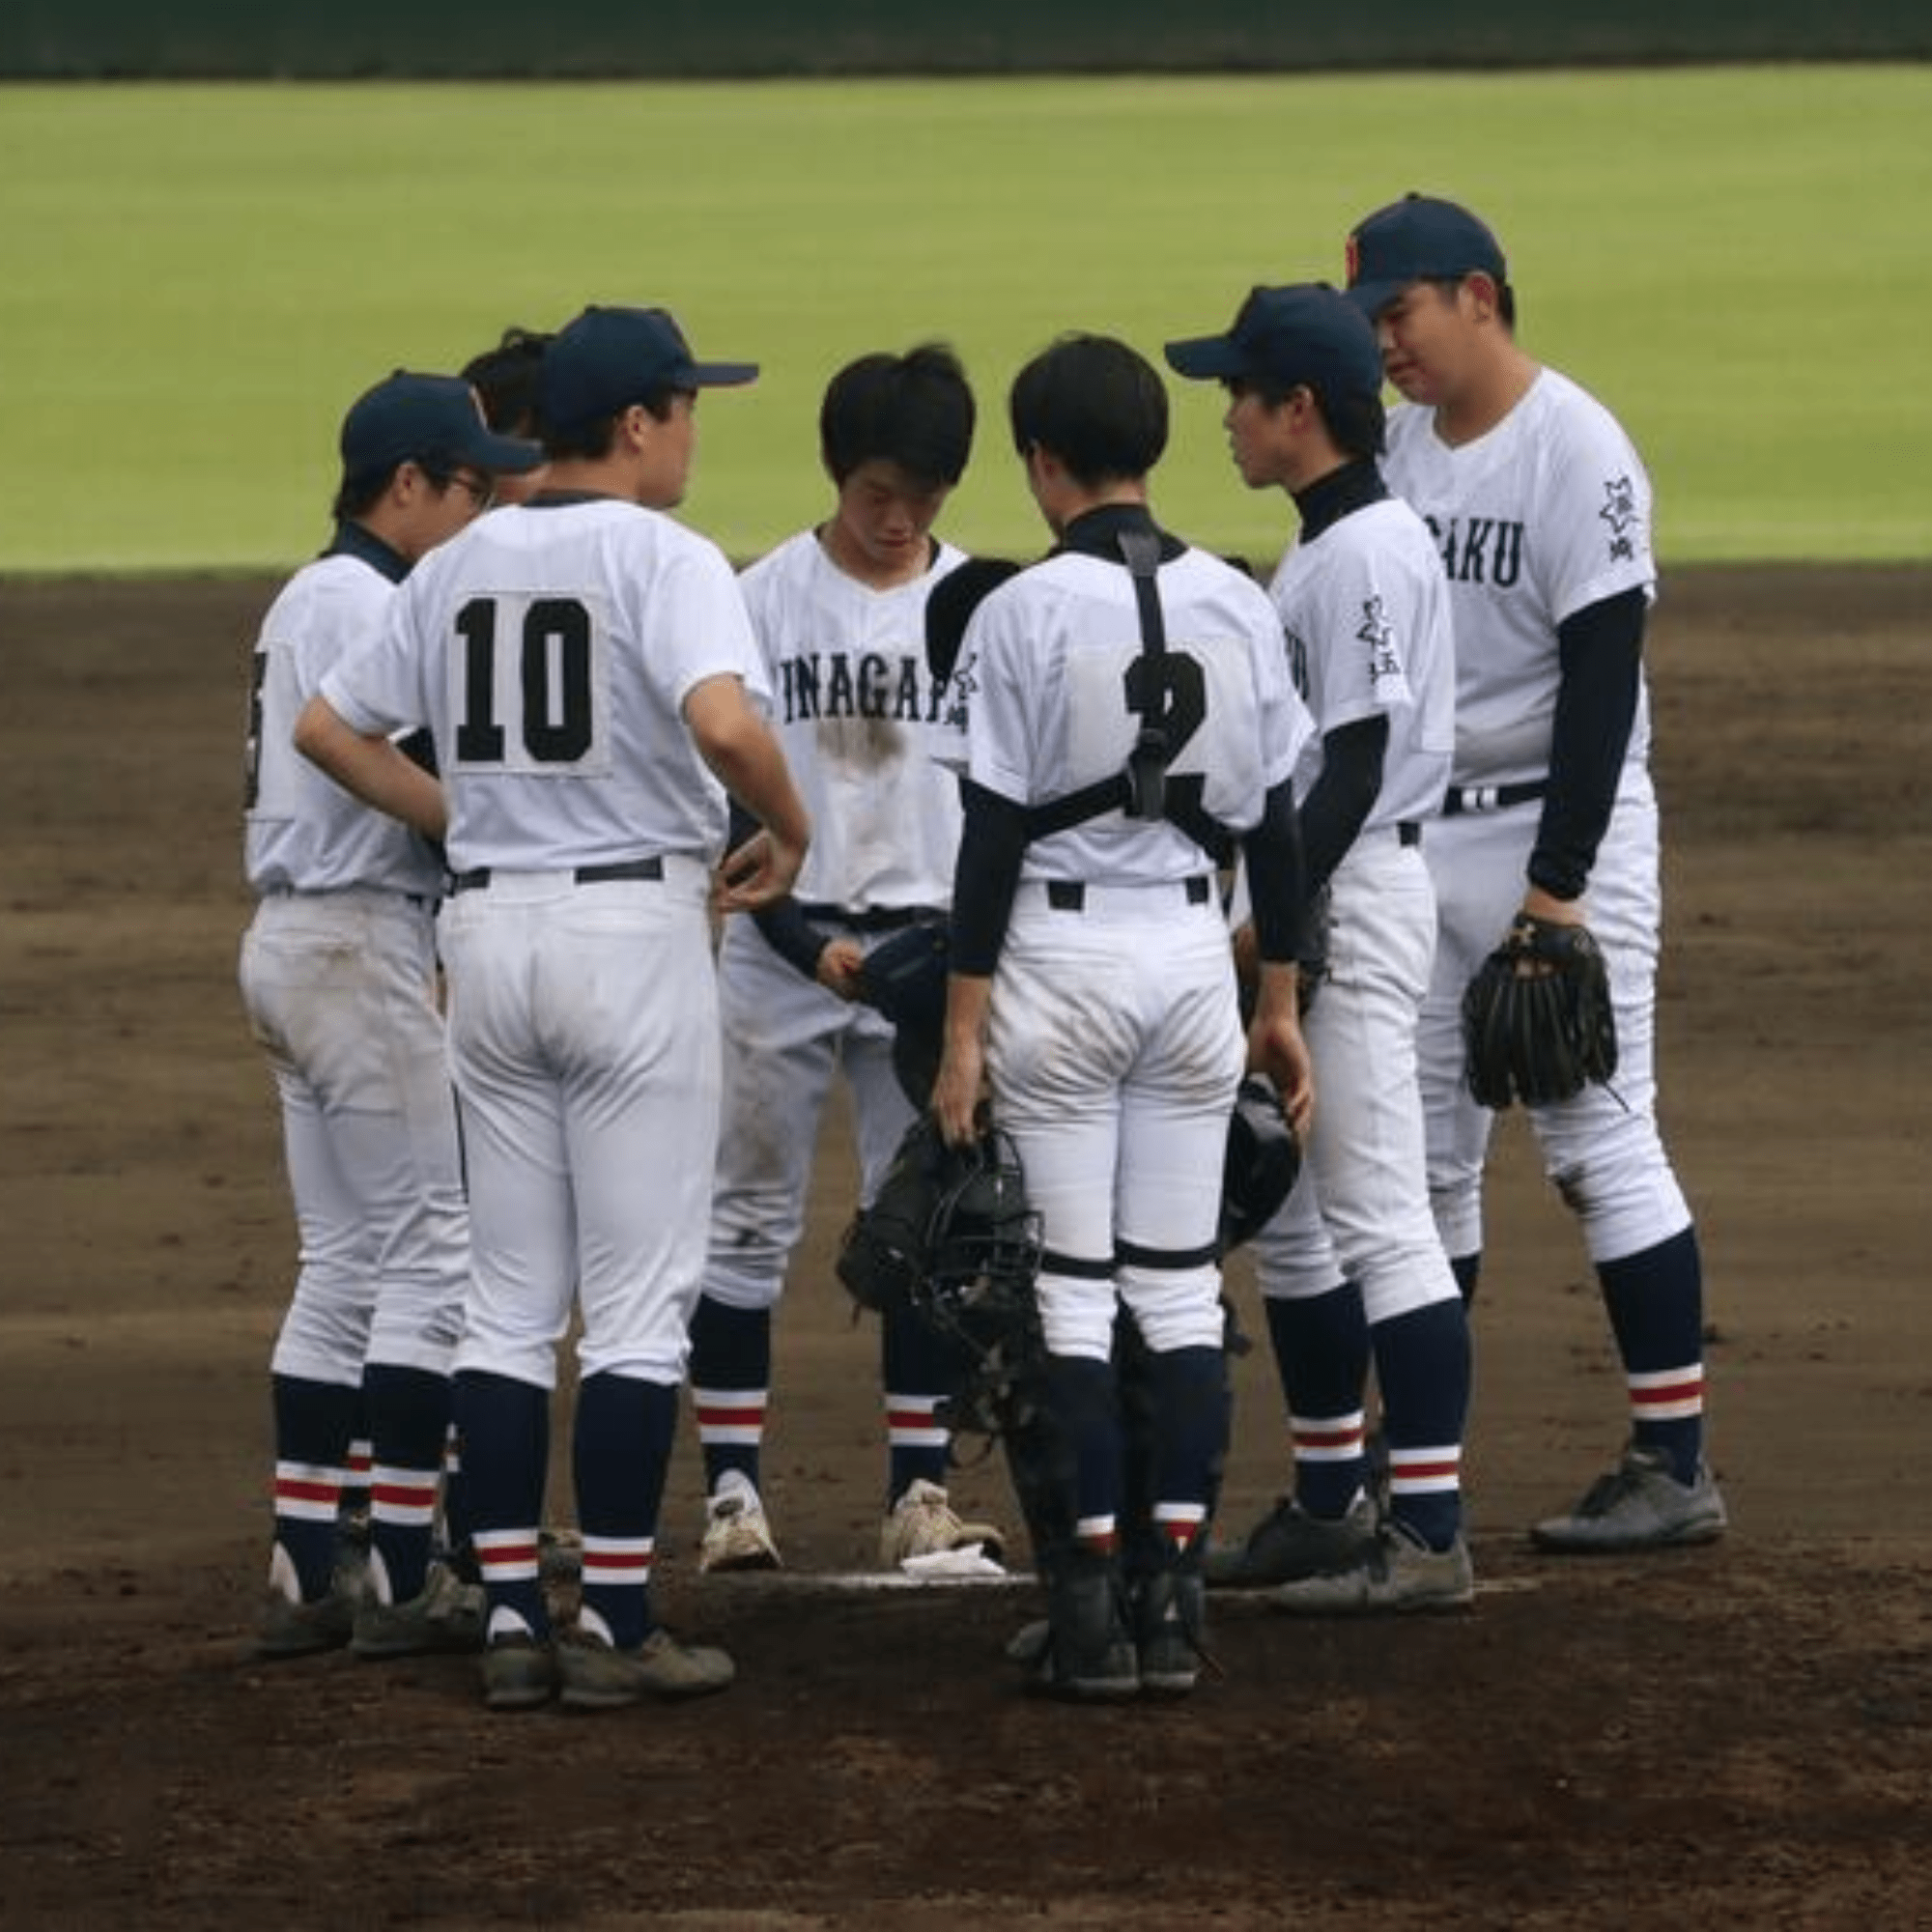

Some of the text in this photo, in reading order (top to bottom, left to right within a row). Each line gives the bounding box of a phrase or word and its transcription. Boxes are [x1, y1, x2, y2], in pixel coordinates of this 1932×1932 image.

[1424, 515, 1523, 587] AKU
[454, 597, 593, 762] 10
[1123, 651, 1206, 817] 2
